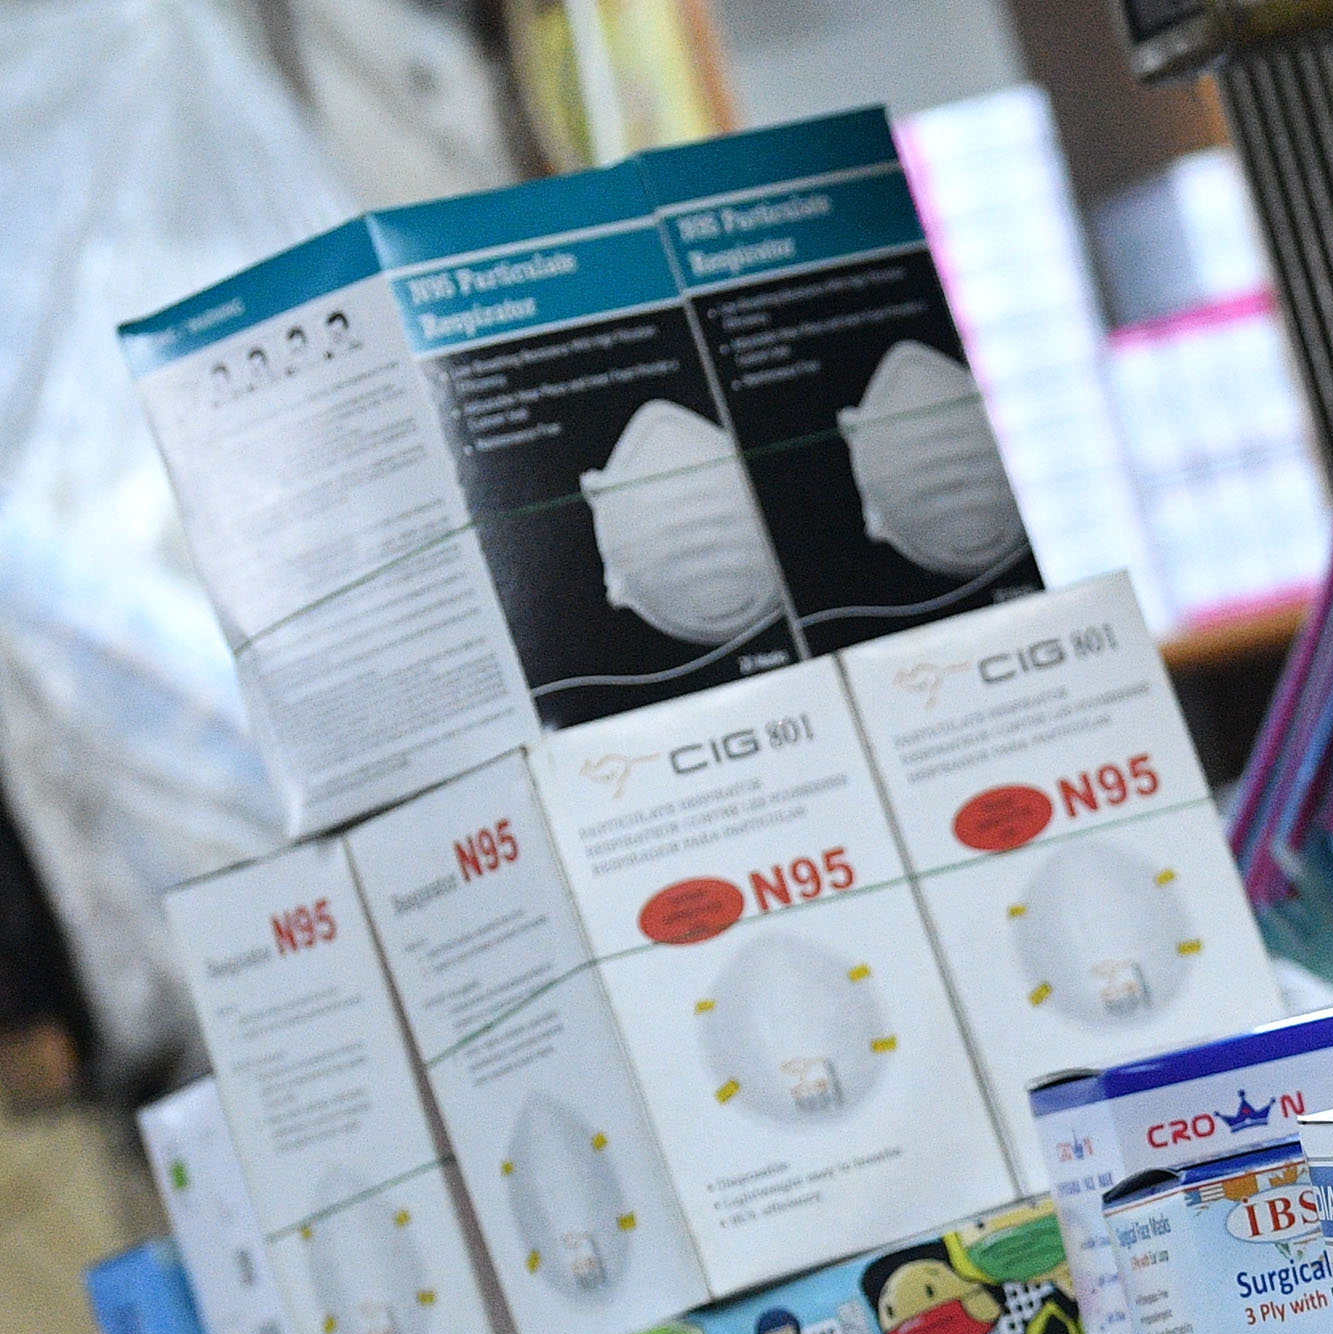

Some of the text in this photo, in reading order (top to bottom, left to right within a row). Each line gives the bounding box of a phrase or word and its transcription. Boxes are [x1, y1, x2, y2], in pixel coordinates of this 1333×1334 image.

[977, 637, 1066, 685] CIG
[669, 713, 814, 775] CIG 801
[1056, 752, 1160, 819] N95
[452, 817, 521, 883] N95
[748, 846, 856, 914] N95
[271, 899, 338, 957] N95
[1237, 1251, 1333, 1299] Surgical
[1245, 1290, 1329, 1328] 3 Ply with
